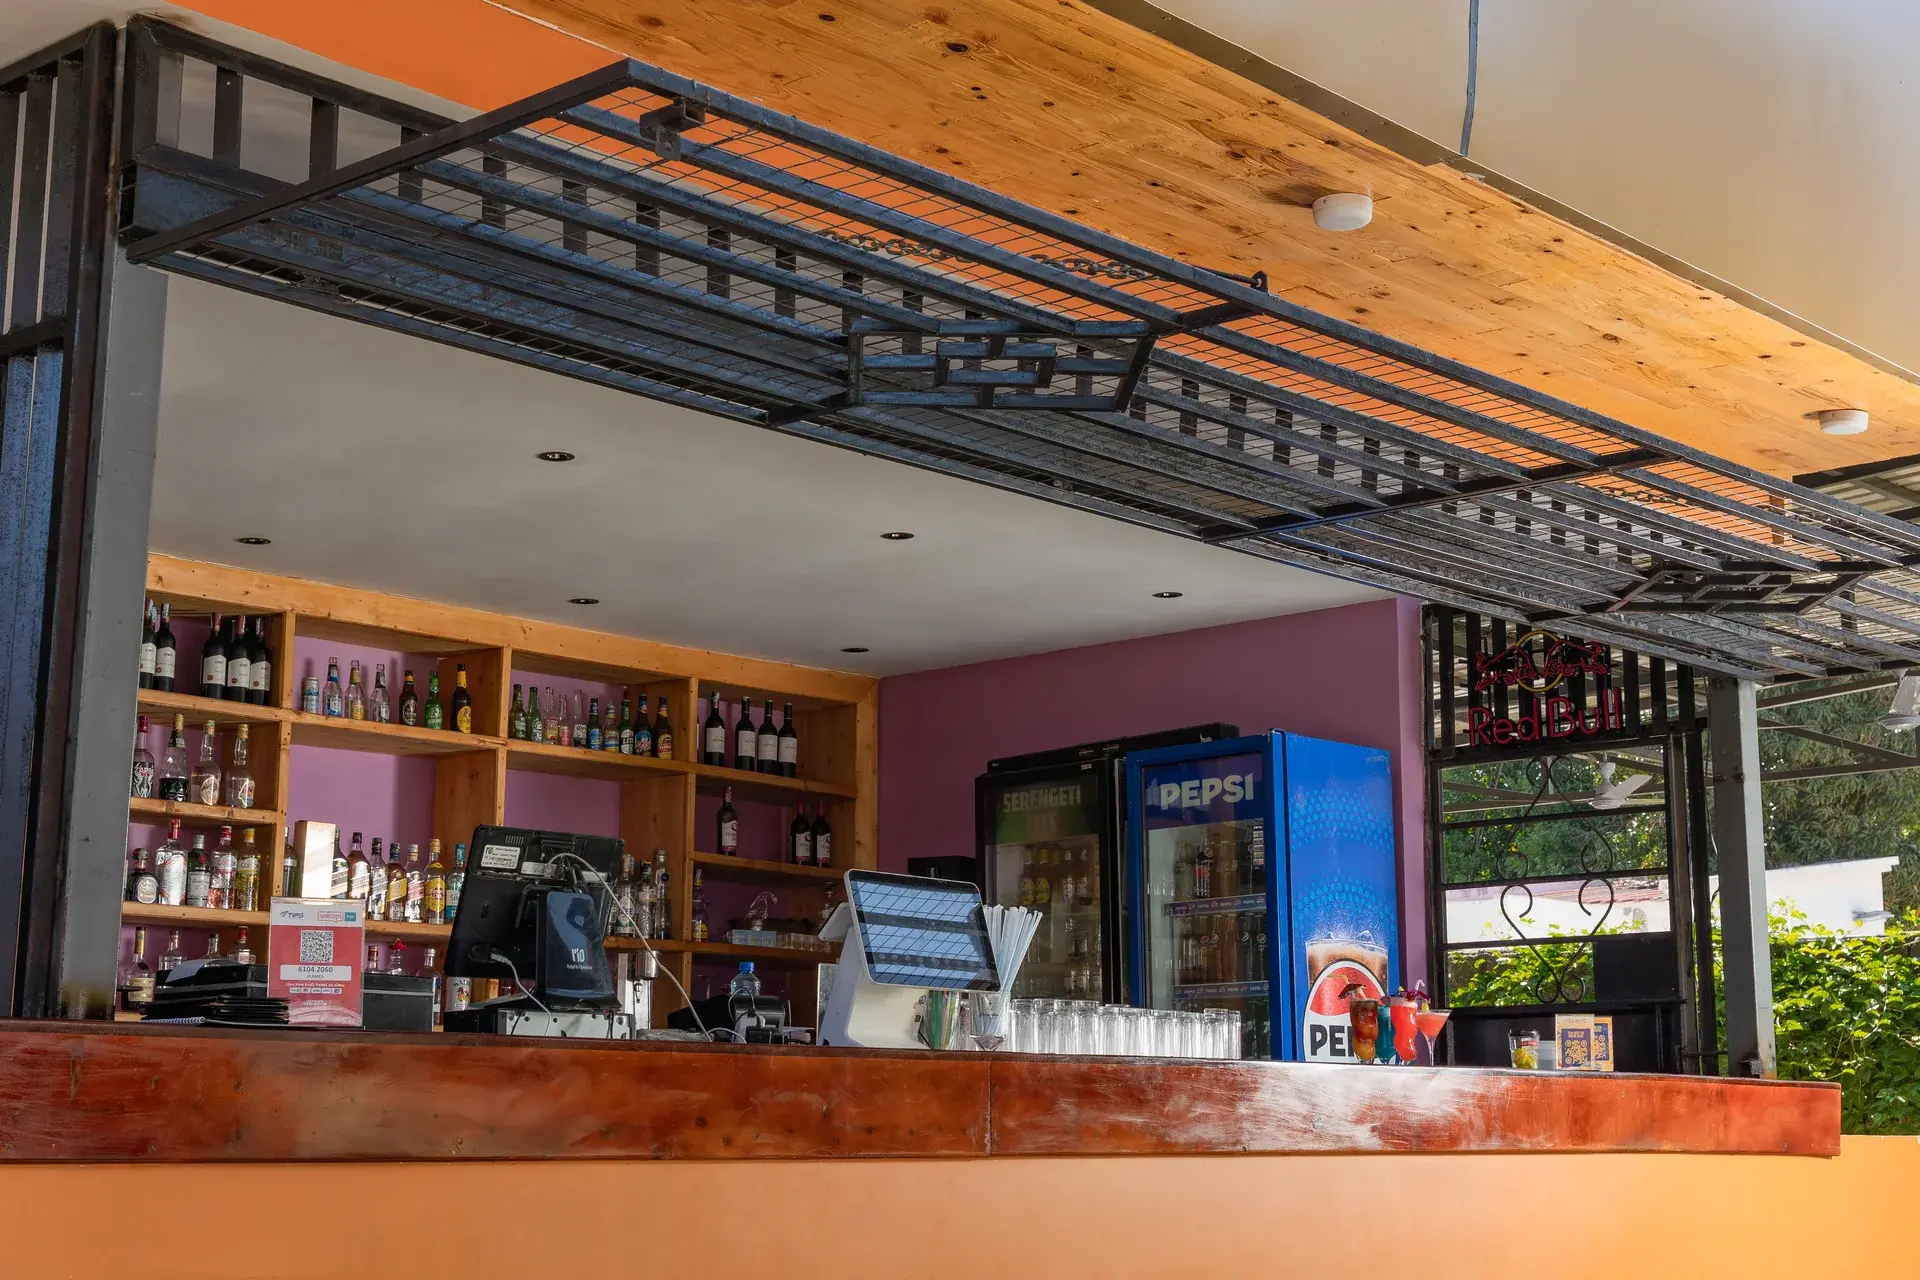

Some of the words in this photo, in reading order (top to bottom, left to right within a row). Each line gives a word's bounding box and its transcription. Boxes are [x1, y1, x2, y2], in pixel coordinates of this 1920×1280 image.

[1468, 696, 1540, 747] Red
[1548, 686, 1621, 738] Bull
[1003, 784, 1081, 813] SERENGETI
[1160, 772, 1254, 810] PEPSI
[571, 947, 585, 962] rio
[1309, 1024, 1354, 1057] PE
